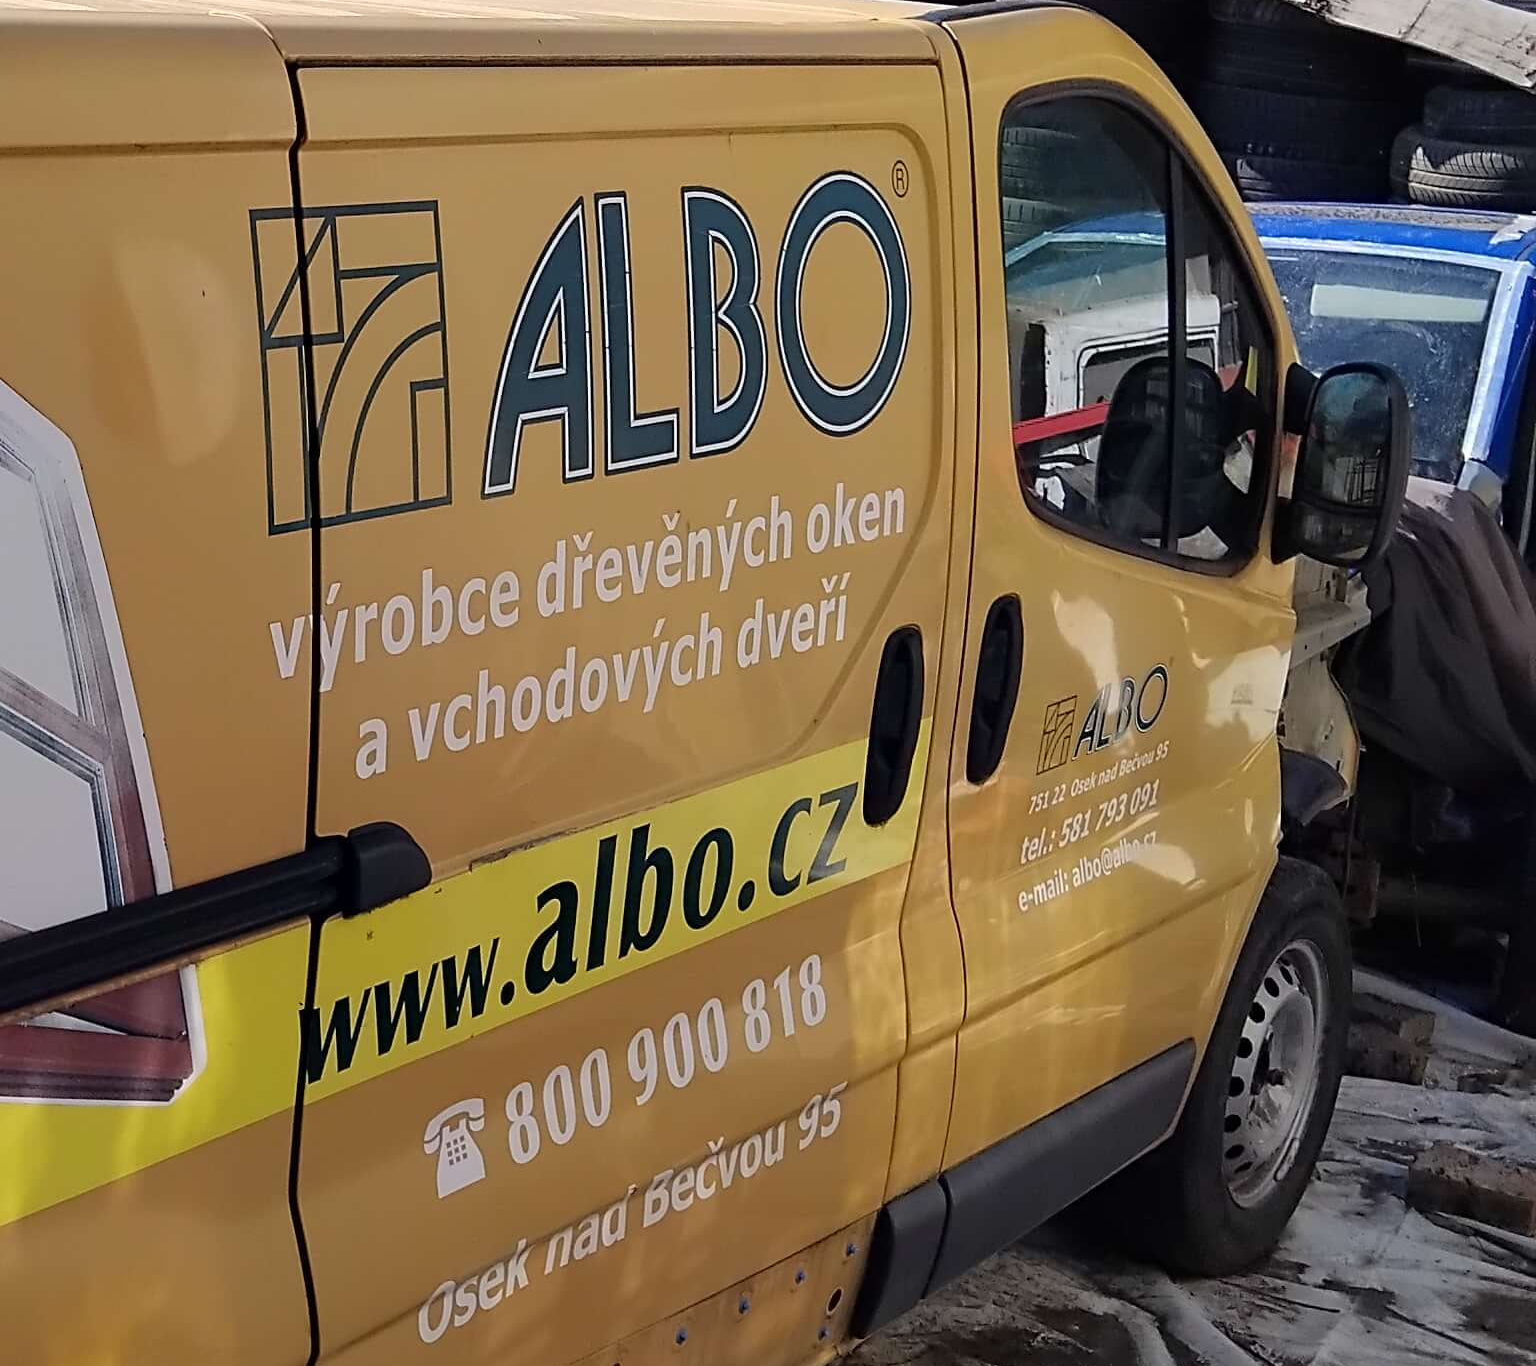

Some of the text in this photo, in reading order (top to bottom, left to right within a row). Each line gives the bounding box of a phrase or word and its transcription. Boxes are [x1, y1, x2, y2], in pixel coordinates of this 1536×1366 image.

[481, 170, 911, 499] ALBO
[268, 482, 906, 693] výrobce dřevěných oken
[354, 572, 852, 781] a vchodových dveří
[1028, 789, 1051, 816] 751
[1051, 783, 1067, 805] 22
[1070, 771, 1098, 797] Osek
[1097, 762, 1119, 786] nad
[1155, 740, 1170, 763] 95
[1071, 663, 1168, 762] ALBO
[1018, 867, 1070, 913] e-mail:
[1020, 778, 1161, 865] tel.: 581 793 091
[298, 781, 860, 1085] www.albo.cz
[505, 953, 828, 1165] 800 900 818
[417, 1081, 849, 1345] Osek nad Bečvou 95
